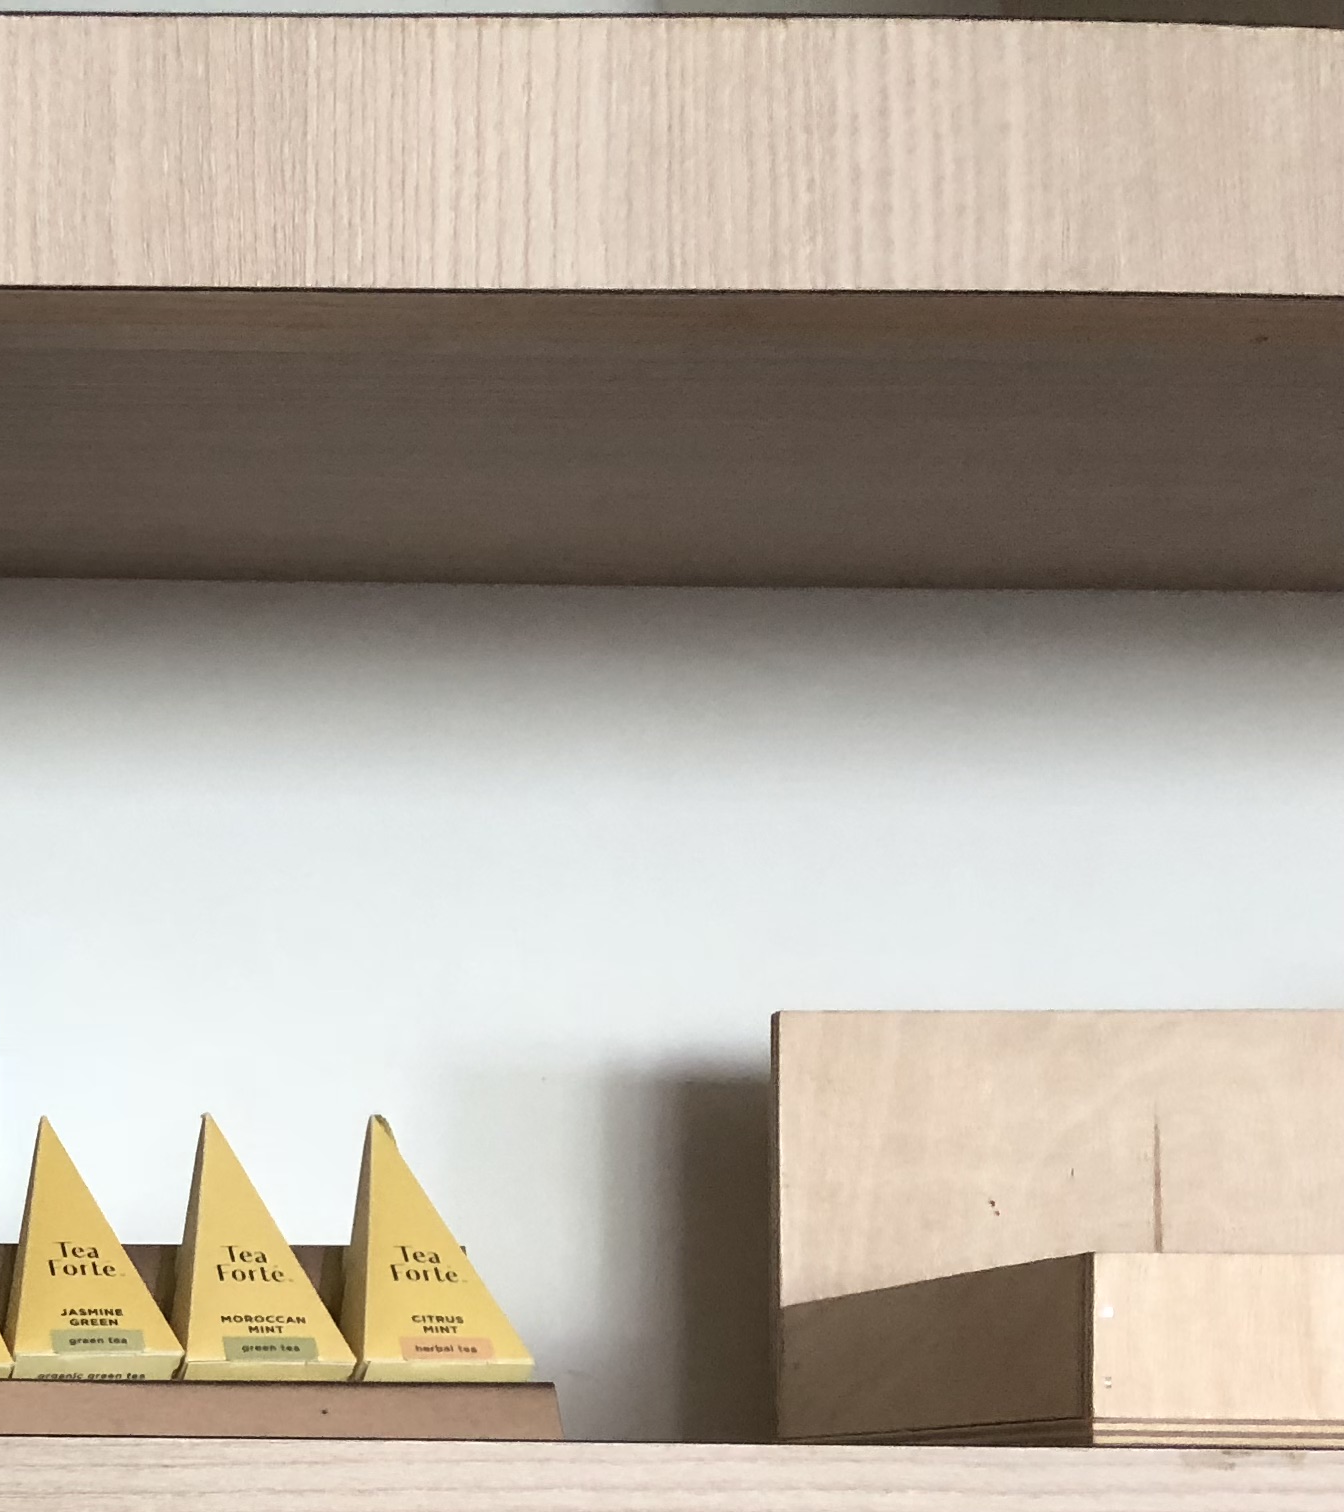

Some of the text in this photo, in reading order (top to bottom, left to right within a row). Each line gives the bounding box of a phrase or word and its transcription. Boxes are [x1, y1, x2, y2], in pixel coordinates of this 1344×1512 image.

[53, 1241, 100, 1259] Tea
[221, 1245, 268, 1264] Tea
[393, 1245, 441, 1264] Tea
[60, 1308, 123, 1316] JASMINE
[70, 1318, 119, 1327] GREEN
[220, 1315, 306, 1324] MOROCCAN
[411, 1315, 464, 1324] CITRUS
[248, 1326, 284, 1334] MINT
[423, 1326, 459, 1334] MINT
[69, 1336, 128, 1346] green tea
[241, 1344, 301, 1353] green tea
[415, 1345, 454, 1353] herbal
